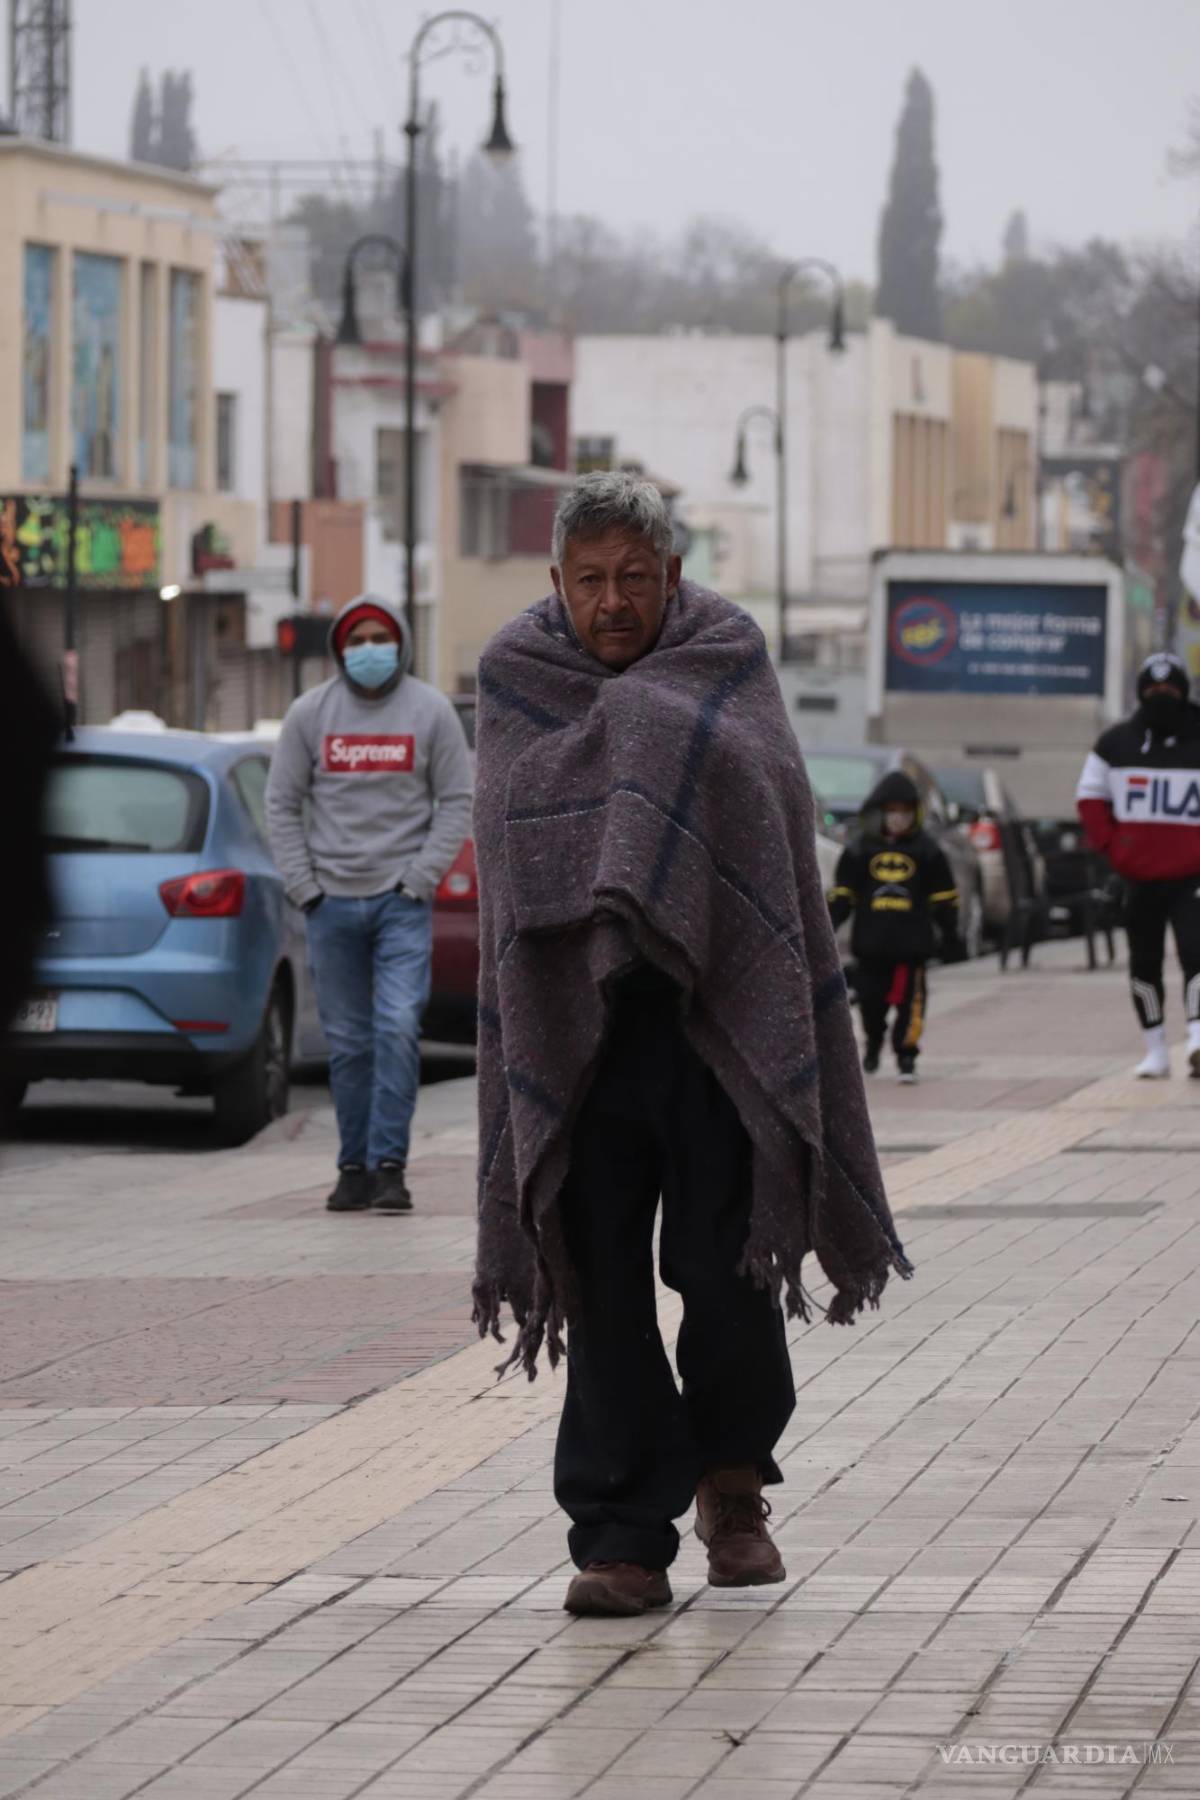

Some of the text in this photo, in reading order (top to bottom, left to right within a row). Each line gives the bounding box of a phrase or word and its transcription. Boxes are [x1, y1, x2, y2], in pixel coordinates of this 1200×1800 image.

[1043, 613, 1101, 635] forma
[959, 632, 984, 649] de
[986, 633, 1065, 652] comprar
[330, 738, 407, 769] Supreme
[1126, 776, 1200, 818] FILA
